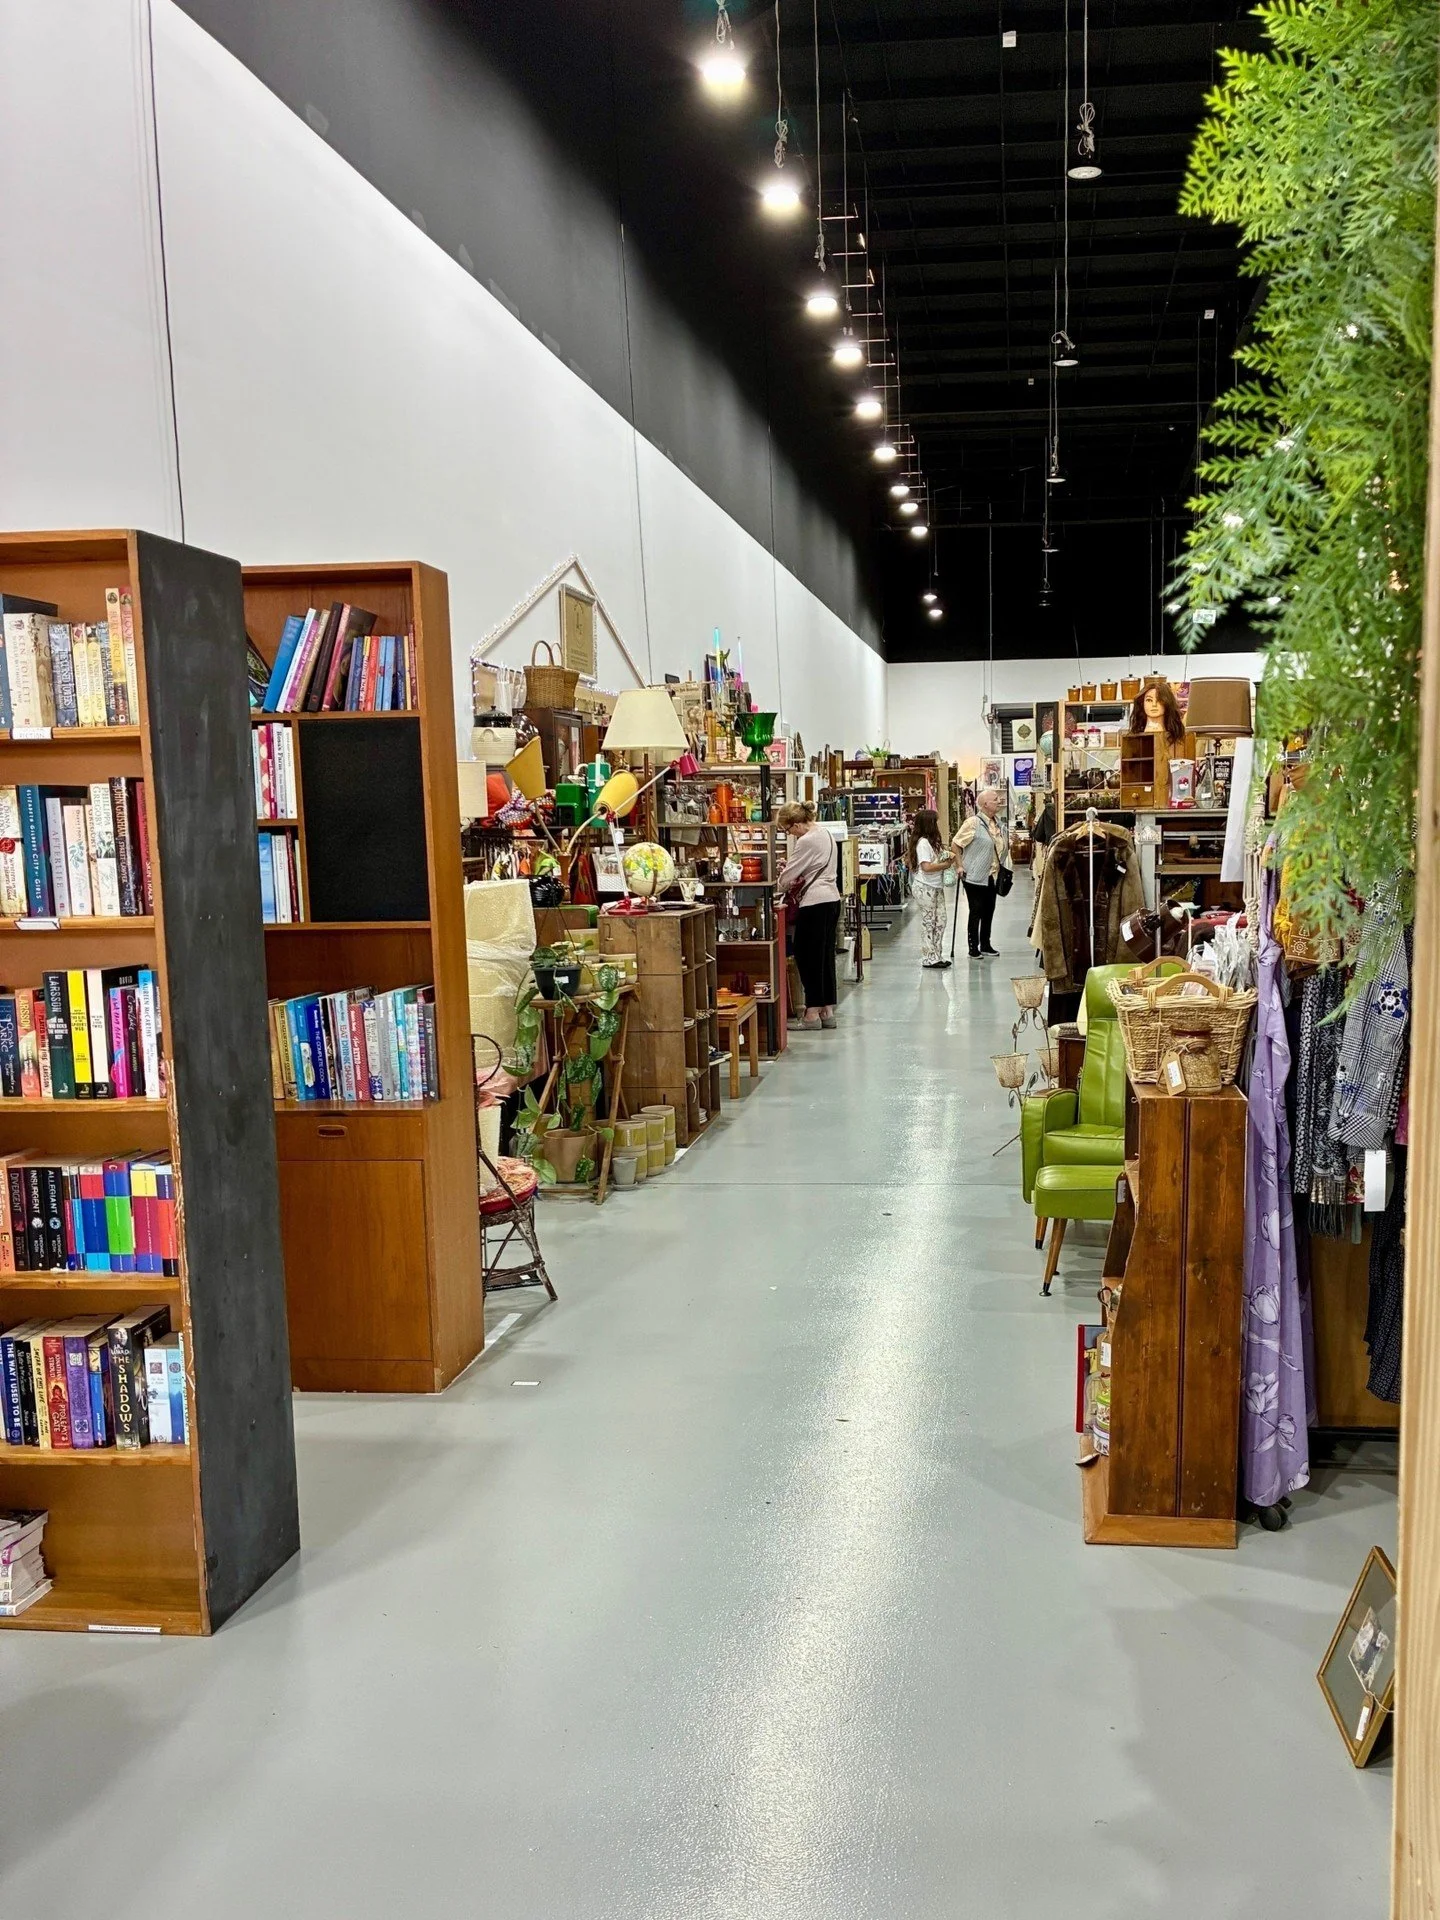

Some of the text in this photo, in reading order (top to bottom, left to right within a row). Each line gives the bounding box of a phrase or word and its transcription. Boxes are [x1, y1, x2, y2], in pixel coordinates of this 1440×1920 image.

[109, 610, 122, 668] FULL CIRCLE
[122, 610, 135, 646] BLOOD
[18, 635, 31, 704] KEN FOLLETT
[126, 647, 135, 668] TIES
[92, 786, 104, 827] GREGORY
[101, 787, 112, 826] PHILIPPA
[113, 786, 127, 838] JOHN GRISHAM
[32, 853, 40, 870] CITY
[52, 830, 65, 889] AFTERLIFE
[34, 878, 43, 900] GIRLS
[49, 975, 62, 1013] LARSSON
[19, 994, 31, 1029] LARSSON
[340, 1025, 348, 1039] EAT
[425, 1018, 434, 1035] raw
[316, 1041, 324, 1068] COMPLETE
[341, 1039, 351, 1065] DRINK
[42, 1065, 50, 1088] LARSSON
[344, 1065, 354, 1091] SHARE
[10, 1172, 22, 1212] DIVERGENT
[30, 1170, 41, 1214] INSURGENT
[47, 1169, 58, 1214] ALLEGIANT
[6, 1343, 15, 1359] THE
[33, 1348, 41, 1366] SWEAR
[113, 1356, 130, 1364] THE
[8, 1360, 17, 1378] WAY
[36, 1367, 42, 1375] ON
[48, 1356, 57, 1378] STROUD
[54, 1354, 63, 1381] JONATHAN
[11, 1382, 20, 1404] USED
[117, 1365, 132, 1433] SHADOWS
[12, 1405, 20, 1416] TO
[14, 1417, 21, 1428] BE
[52, 1411, 61, 1432] GATE
[59, 1404, 68, 1442] PTOLEMY'S
